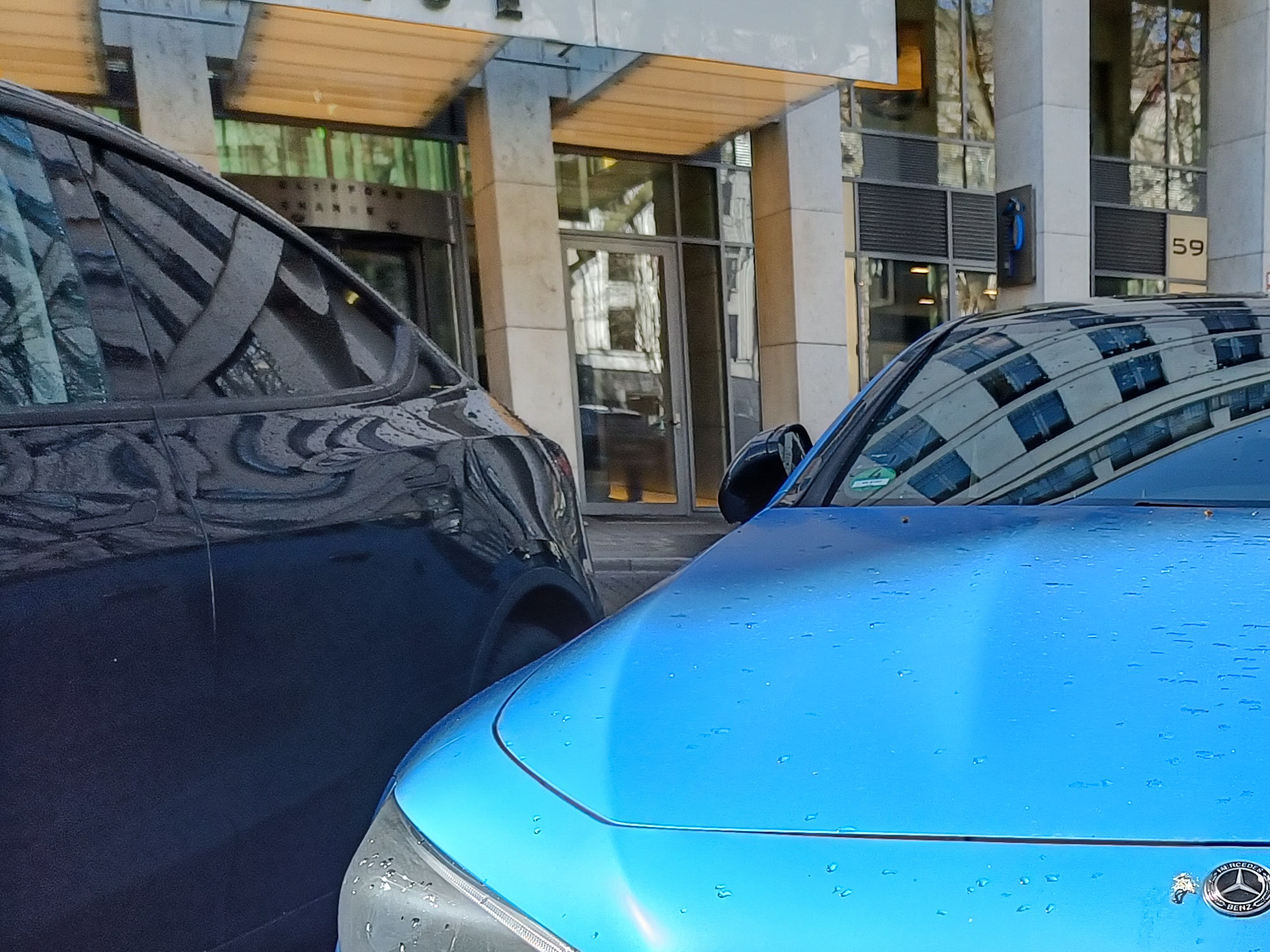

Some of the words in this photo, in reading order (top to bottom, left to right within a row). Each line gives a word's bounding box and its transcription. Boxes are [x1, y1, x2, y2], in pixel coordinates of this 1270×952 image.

[1172, 237, 1204, 256] 59
[1216, 861, 1264, 873] MERCEDES
[1226, 903, 1253, 912] BENZ
